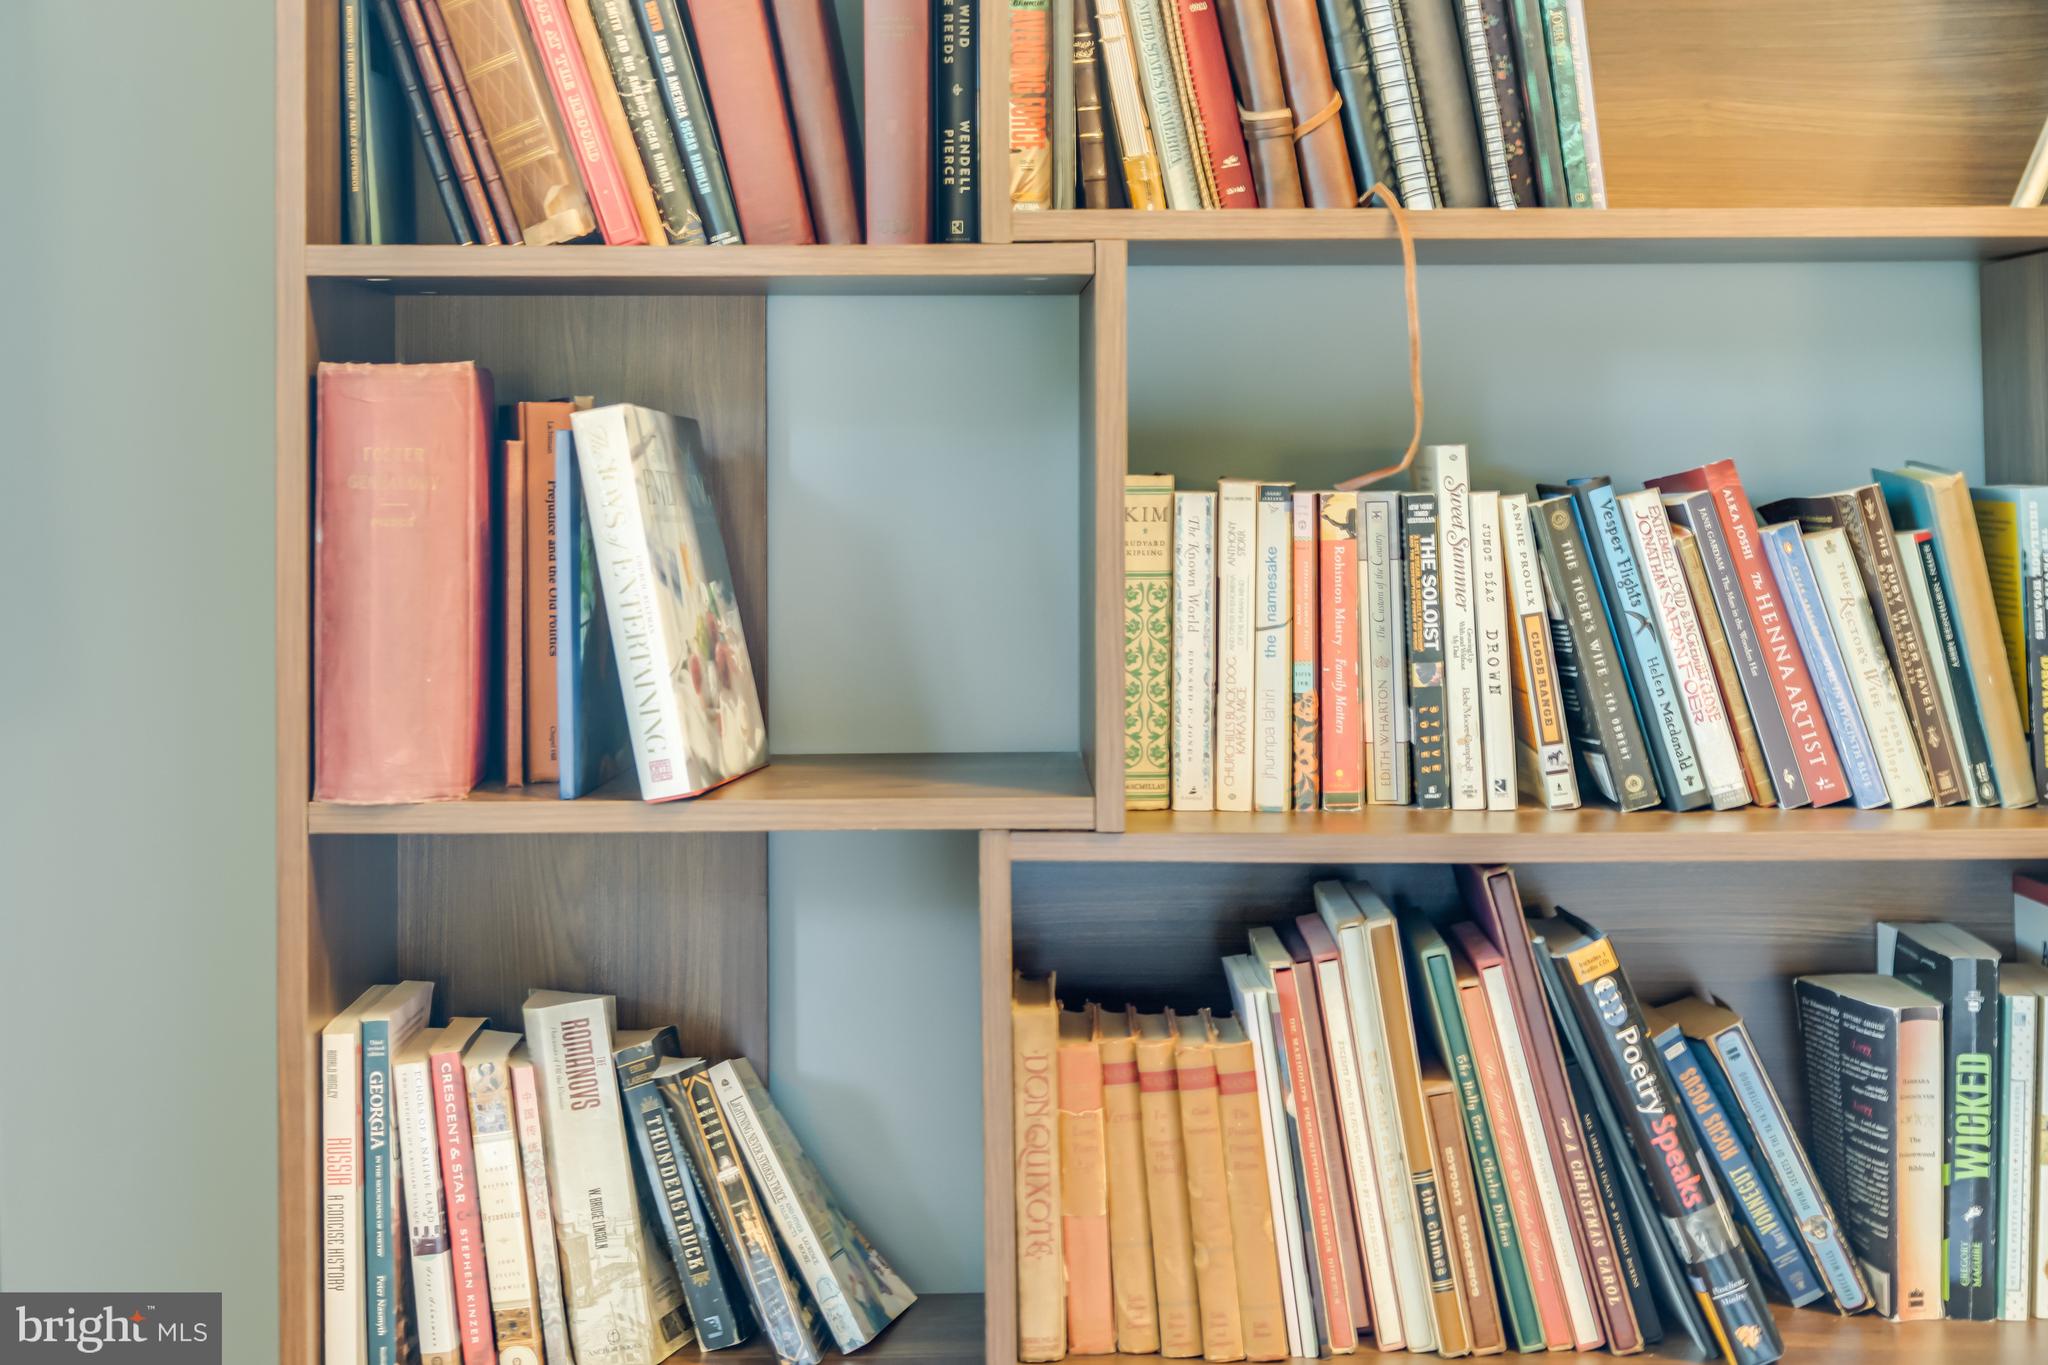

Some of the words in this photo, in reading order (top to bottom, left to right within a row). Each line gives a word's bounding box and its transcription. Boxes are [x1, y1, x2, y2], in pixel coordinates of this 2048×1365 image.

[603, 0, 623, 32] SMITH
[642, 0, 665, 33] SMITH
[942, 13, 953, 64] REEDS
[958, 4, 970, 47] WIND
[613, 32, 630, 54] AND
[620, 53, 637, 74] HIS
[652, 32, 671, 55] AND
[658, 53, 677, 74] HIS
[1011, 11, 1045, 91] AVENGING
[626, 72, 651, 119] AMERICA
[664, 73, 690, 119] AMERICA
[640, 117, 661, 151] OSCAR
[678, 117, 700, 152] OSCAR
[1009, 98, 1045, 148] FORCE
[651, 150, 675, 194] HANDLIN
[687, 151, 713, 195] HANDLIN
[942, 128, 953, 184] PIERCE
[958, 120, 970, 193] WENDELL
[544, 479, 556, 537] Prejudice
[1124, 506, 1168, 523] KIM
[1442, 473, 1471, 532] Sweet
[1696, 505, 1713, 532] JANE
[1720, 486, 1741, 524] ALKA
[1731, 521, 1754, 561] JOSHI
[1187, 517, 1200, 537] The
[1226, 521, 1238, 566] ANTHONY
[1480, 522, 1493, 562] JUNOT
[545, 538, 557, 562] and
[1126, 549, 1163, 557] KIPLING
[1183, 542, 1200, 587] Known
[1417, 533, 1437, 571] THE
[1445, 528, 1477, 614] Summer
[1508, 501, 1526, 547] ANNIE
[1517, 550, 1536, 608] PROULX
[1600, 498, 1627, 556] Vesper
[1615, 557, 1642, 608] Flights
[1704, 529, 1726, 571] GARDAM
[545, 564, 557, 584] the
[1263, 545, 1278, 622] namesake
[1332, 545, 1345, 604] Rohinton
[1483, 570, 1498, 603] DÍAZ
[1749, 570, 1766, 592] The
[1835, 561, 1851, 589] THE
[547, 586, 558, 611] Old
[1186, 593, 1200, 632] World
[1418, 574, 1443, 652] SOLOIST
[1559, 538, 1579, 570] THE
[1569, 574, 1597, 634] TIGER'S
[1587, 638, 1609, 678] WIFE
[1636, 512, 1668, 591] JONATHAN
[1659, 591, 1689, 663] SAFRAN
[1677, 662, 1705, 727] FOER
[1647, 503, 1676, 571] EXTREMELY
[1667, 573, 1688, 609] LOUD
[1698, 680, 1722, 723] CLOSE
[2032, 579, 2047, 640] HOLMES
[547, 613, 558, 657] Politics
[1331, 607, 1346, 646] Mistry
[1755, 593, 1796, 680] HENNA
[1839, 594, 1870, 666] RECTOR'S
[1872, 527, 1890, 560] THE
[1882, 562, 1903, 605] RUBY
[1895, 608, 1909, 626] IN
[1902, 630, 1920, 664] HER
[1912, 666, 1935, 717] NAVEL
[611, 556, 668, 755] ENTERTAINING
[1263, 634, 1277, 658] the
[1484, 628, 1503, 697] DROWN
[1528, 630, 1547, 675] CLOSE
[1332, 657, 1347, 692] Family
[1862, 666, 1888, 709] WIFE
[1262, 687, 1276, 722] lahiri
[1334, 694, 1346, 734] Matters
[1377, 678, 1389, 743] WHARTON
[1535, 678, 1556, 727] RANGE
[1646, 656, 1666, 697] Helen
[1660, 702, 1693, 772] Macdonald
[1785, 683, 1826, 767] ARTIST
[1261, 725, 1281, 780] jhumpa
[1418, 705, 1431, 774] LOPEZ
[1429, 705, 1441, 772] STEVE
[1380, 750, 1392, 786] EDITH
[559, 1017, 601, 1111] ROMANOVS
[1021, 1052, 1050, 1117] DON
[1454, 1053, 1472, 1078] The
[1614, 1025, 1666, 1115] Poetry
[367, 1070, 385, 1150] GEORGIA
[413, 1070, 427, 1115] ECHOES
[439, 1061, 460, 1145] CRESCENT
[1459, 1079, 1480, 1112] Holly
[1676, 1066, 1709, 1113] POCUS
[416, 1117, 428, 1133] OF
[1469, 1112, 1487, 1142] Tree
[1702, 1112, 1740, 1160] HOCUS
[1954, 1052, 1992, 1181] WICKED
[326, 1137, 353, 1186] RUSSIA
[373, 1154, 382, 1164] IN
[448, 1146, 462, 1160] &
[728, 1094, 759, 1134] LIGHTNING
[744, 1131, 765, 1156] NEVER
[755, 1152, 777, 1183] STRIKES
[767, 1178, 788, 1204] TWICE
[1564, 1140, 1579, 1153] A
[1650, 1112, 1703, 1211] Speaks
[1767, 1132, 1781, 1148] THE
[1774, 1146, 1786, 1159] OF
[373, 1163, 383, 1178] THE
[419, 1147, 432, 1189] NATIVE
[450, 1162, 466, 1204] STAR
[1018, 1122, 1054, 1258] QUIXOTE
[1480, 1156, 1502, 1200] Charles
[1779, 1156, 1800, 1187] SECRETS
[373, 1178, 384, 1219] MOUNTAINS
[422, 1191, 435, 1224] LAND
[645, 1114, 704, 1271] THUNDERSTRUCK
[1420, 1187, 1437, 1216] the
[1569, 1157, 1605, 1249] CHRISTMAS
[1728, 1164, 1768, 1236] VONNEGUT
[1792, 1185, 1811, 1212] DIVINE
[325, 1203, 345, 1245] CONCISE
[374, 1219, 384, 1230] OF
[375, 1229, 385, 1258] POETRY
[1491, 1201, 1514, 1249] Dickens
[326, 1247, 345, 1292] HISTORY
[458, 1227, 475, 1289] STEPHEN
[1426, 1220, 1448, 1277] chimes
[1959, 1239, 1970, 1287] GREGORY
[375, 1274, 386, 1297] Peter
[1595, 1254, 1621, 1307] CAROL
[374, 1298, 388, 1337] Nasmyth
[465, 1293, 480, 1344] KINZER
